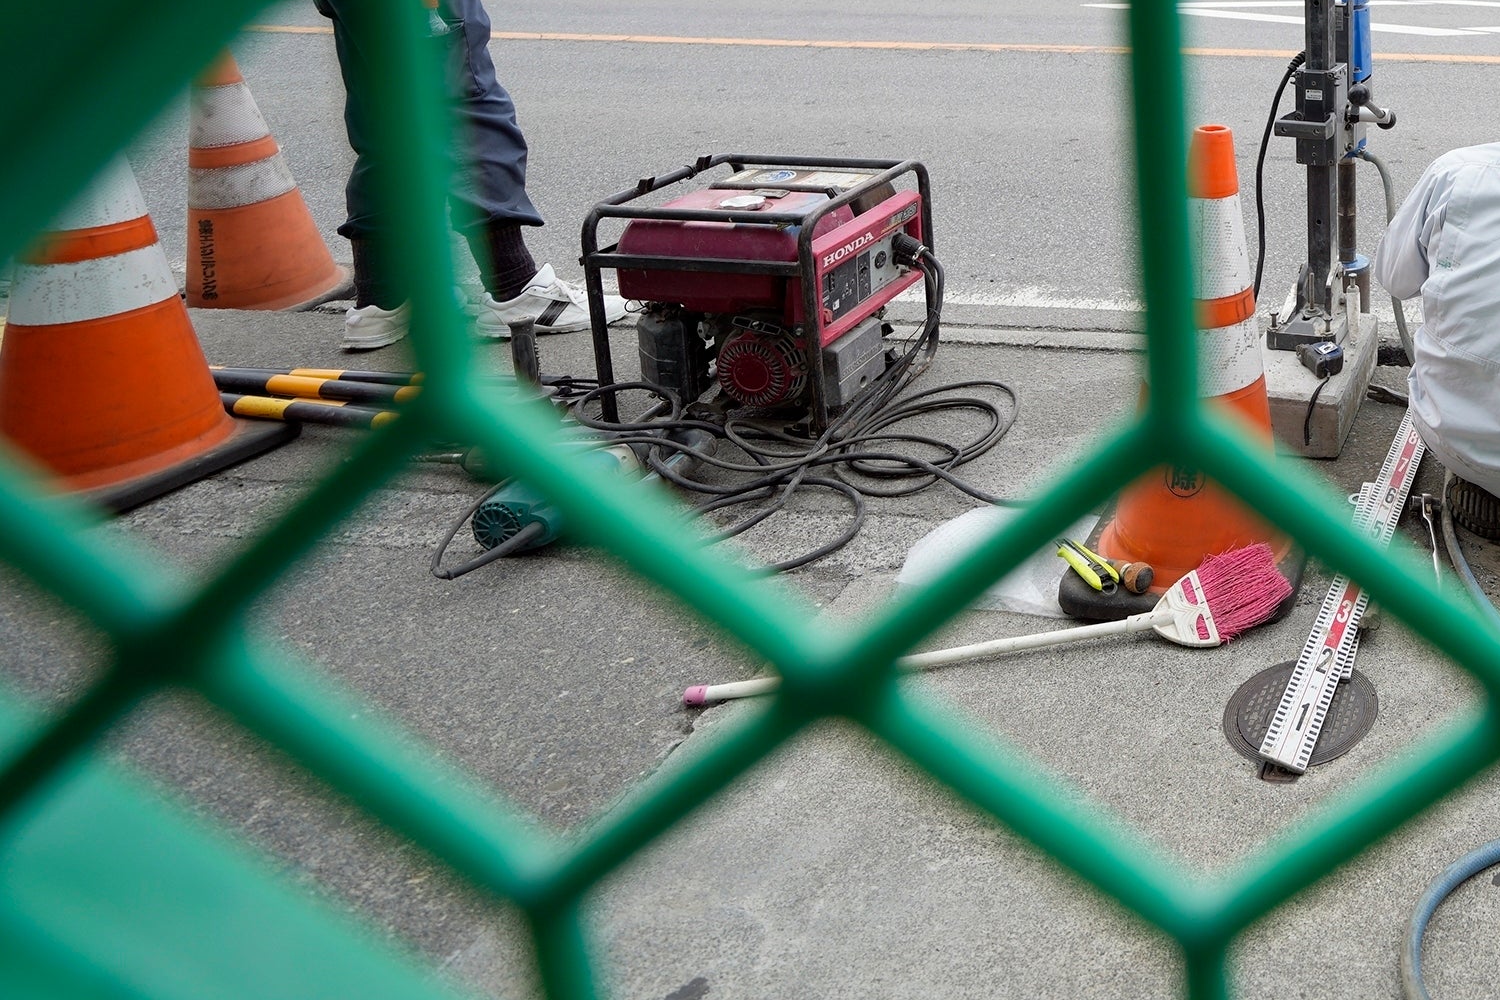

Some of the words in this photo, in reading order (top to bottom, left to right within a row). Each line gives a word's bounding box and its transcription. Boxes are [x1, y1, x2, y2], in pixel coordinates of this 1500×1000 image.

[823, 232, 875, 268] HONDA
[1408, 430, 1418, 445] 8
[1398, 457, 1410, 472] 7
[1385, 487, 1397, 504] 6
[1337, 600, 1352, 624] 3
[1315, 648, 1333, 674] 2
[1296, 703, 1310, 731] 1
